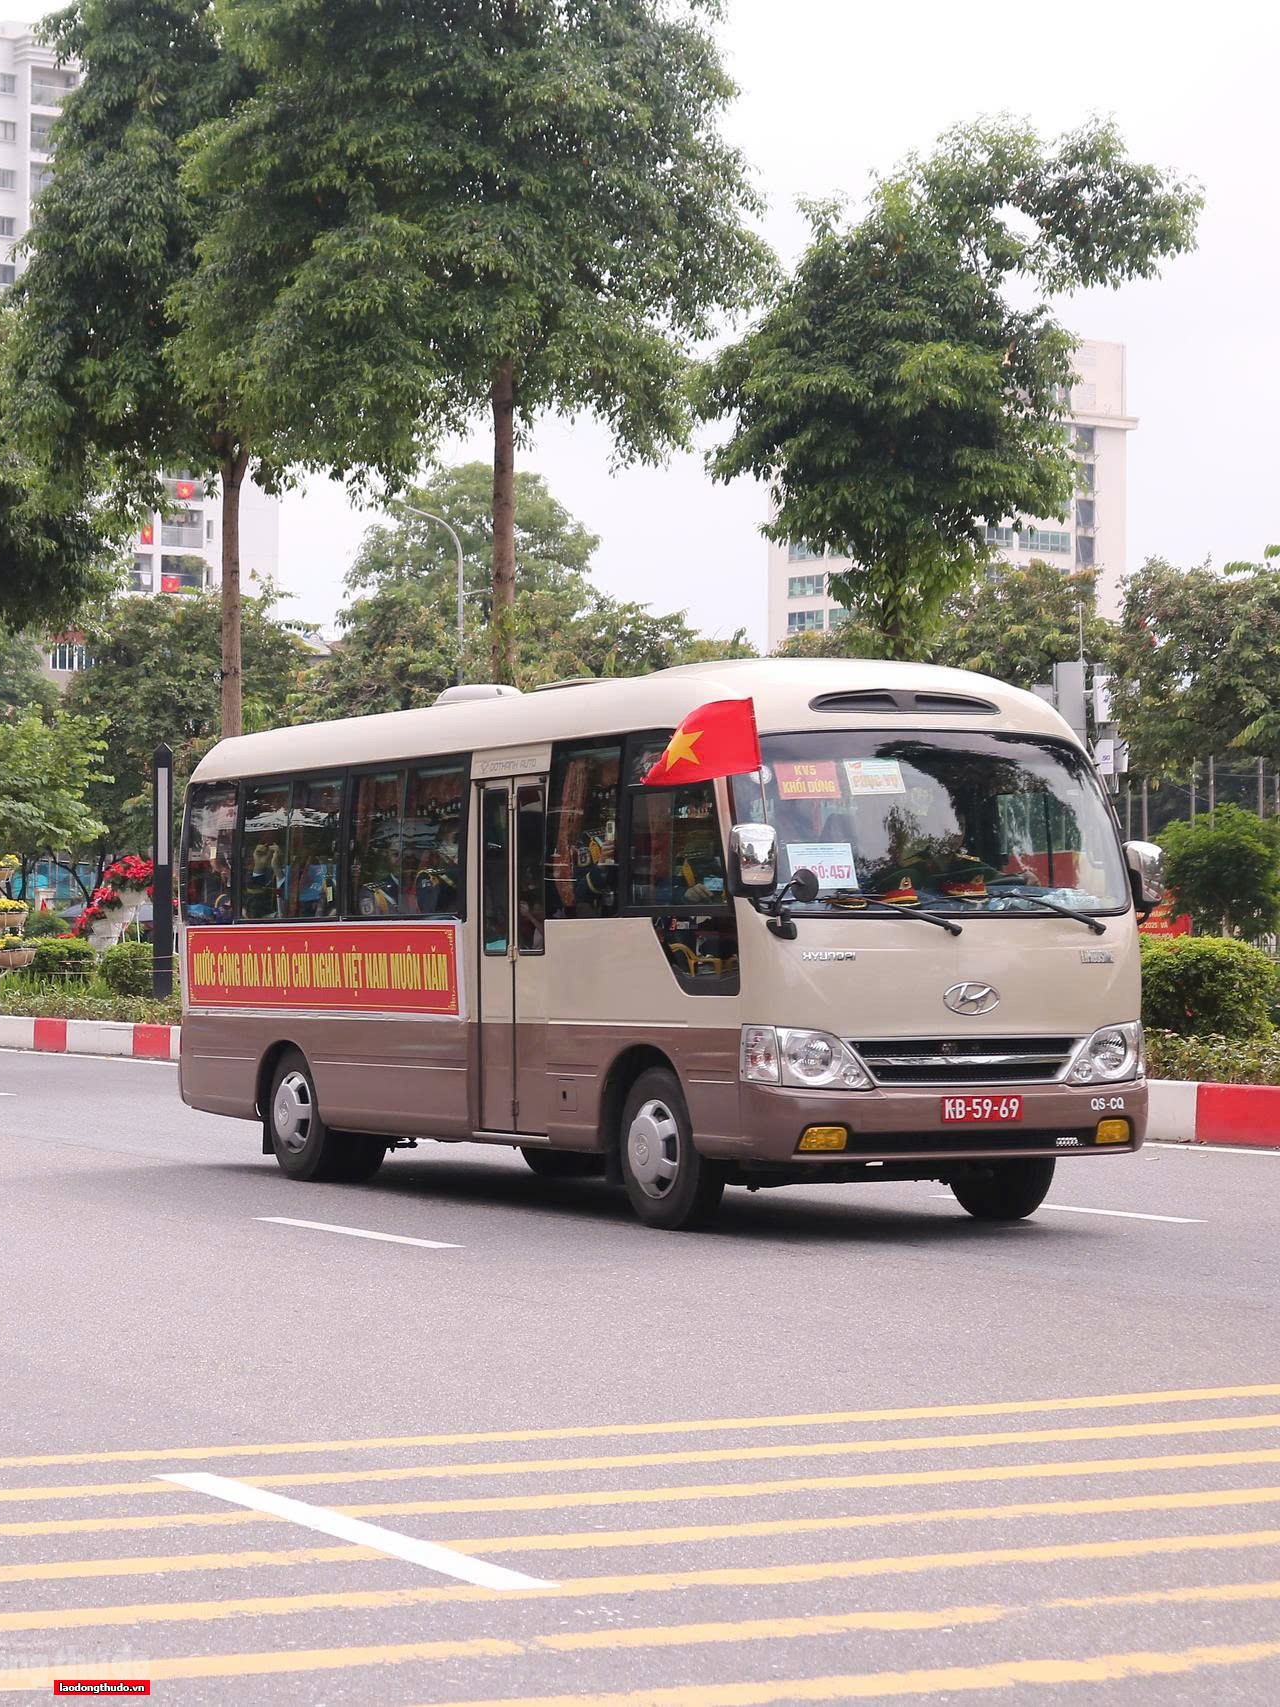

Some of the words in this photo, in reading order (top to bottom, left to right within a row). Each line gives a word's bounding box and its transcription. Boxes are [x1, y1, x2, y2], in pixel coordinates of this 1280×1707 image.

[794, 765, 816, 776] KV5
[802, 951, 856, 961] HYUNDAI
[193, 945, 216, 986] NƯỚC
[218, 945, 240, 994] CỘNG
[242, 944, 260, 987] HÒA
[261, 946, 274, 987] XÃ
[275, 945, 290, 995] HỘI
[292, 940, 311, 988] CHỦ
[312, 946, 342, 988] NGHĨA
[342, 945, 362, 997] VIỆT
[364, 953, 388, 989] NAM
[391, 945, 421, 990] MUÔN
[423, 944, 449, 991] NĂM
[944, 1098, 1020, 1119] KB-59-69
[1090, 1097, 1125, 1111] QS-CQ
